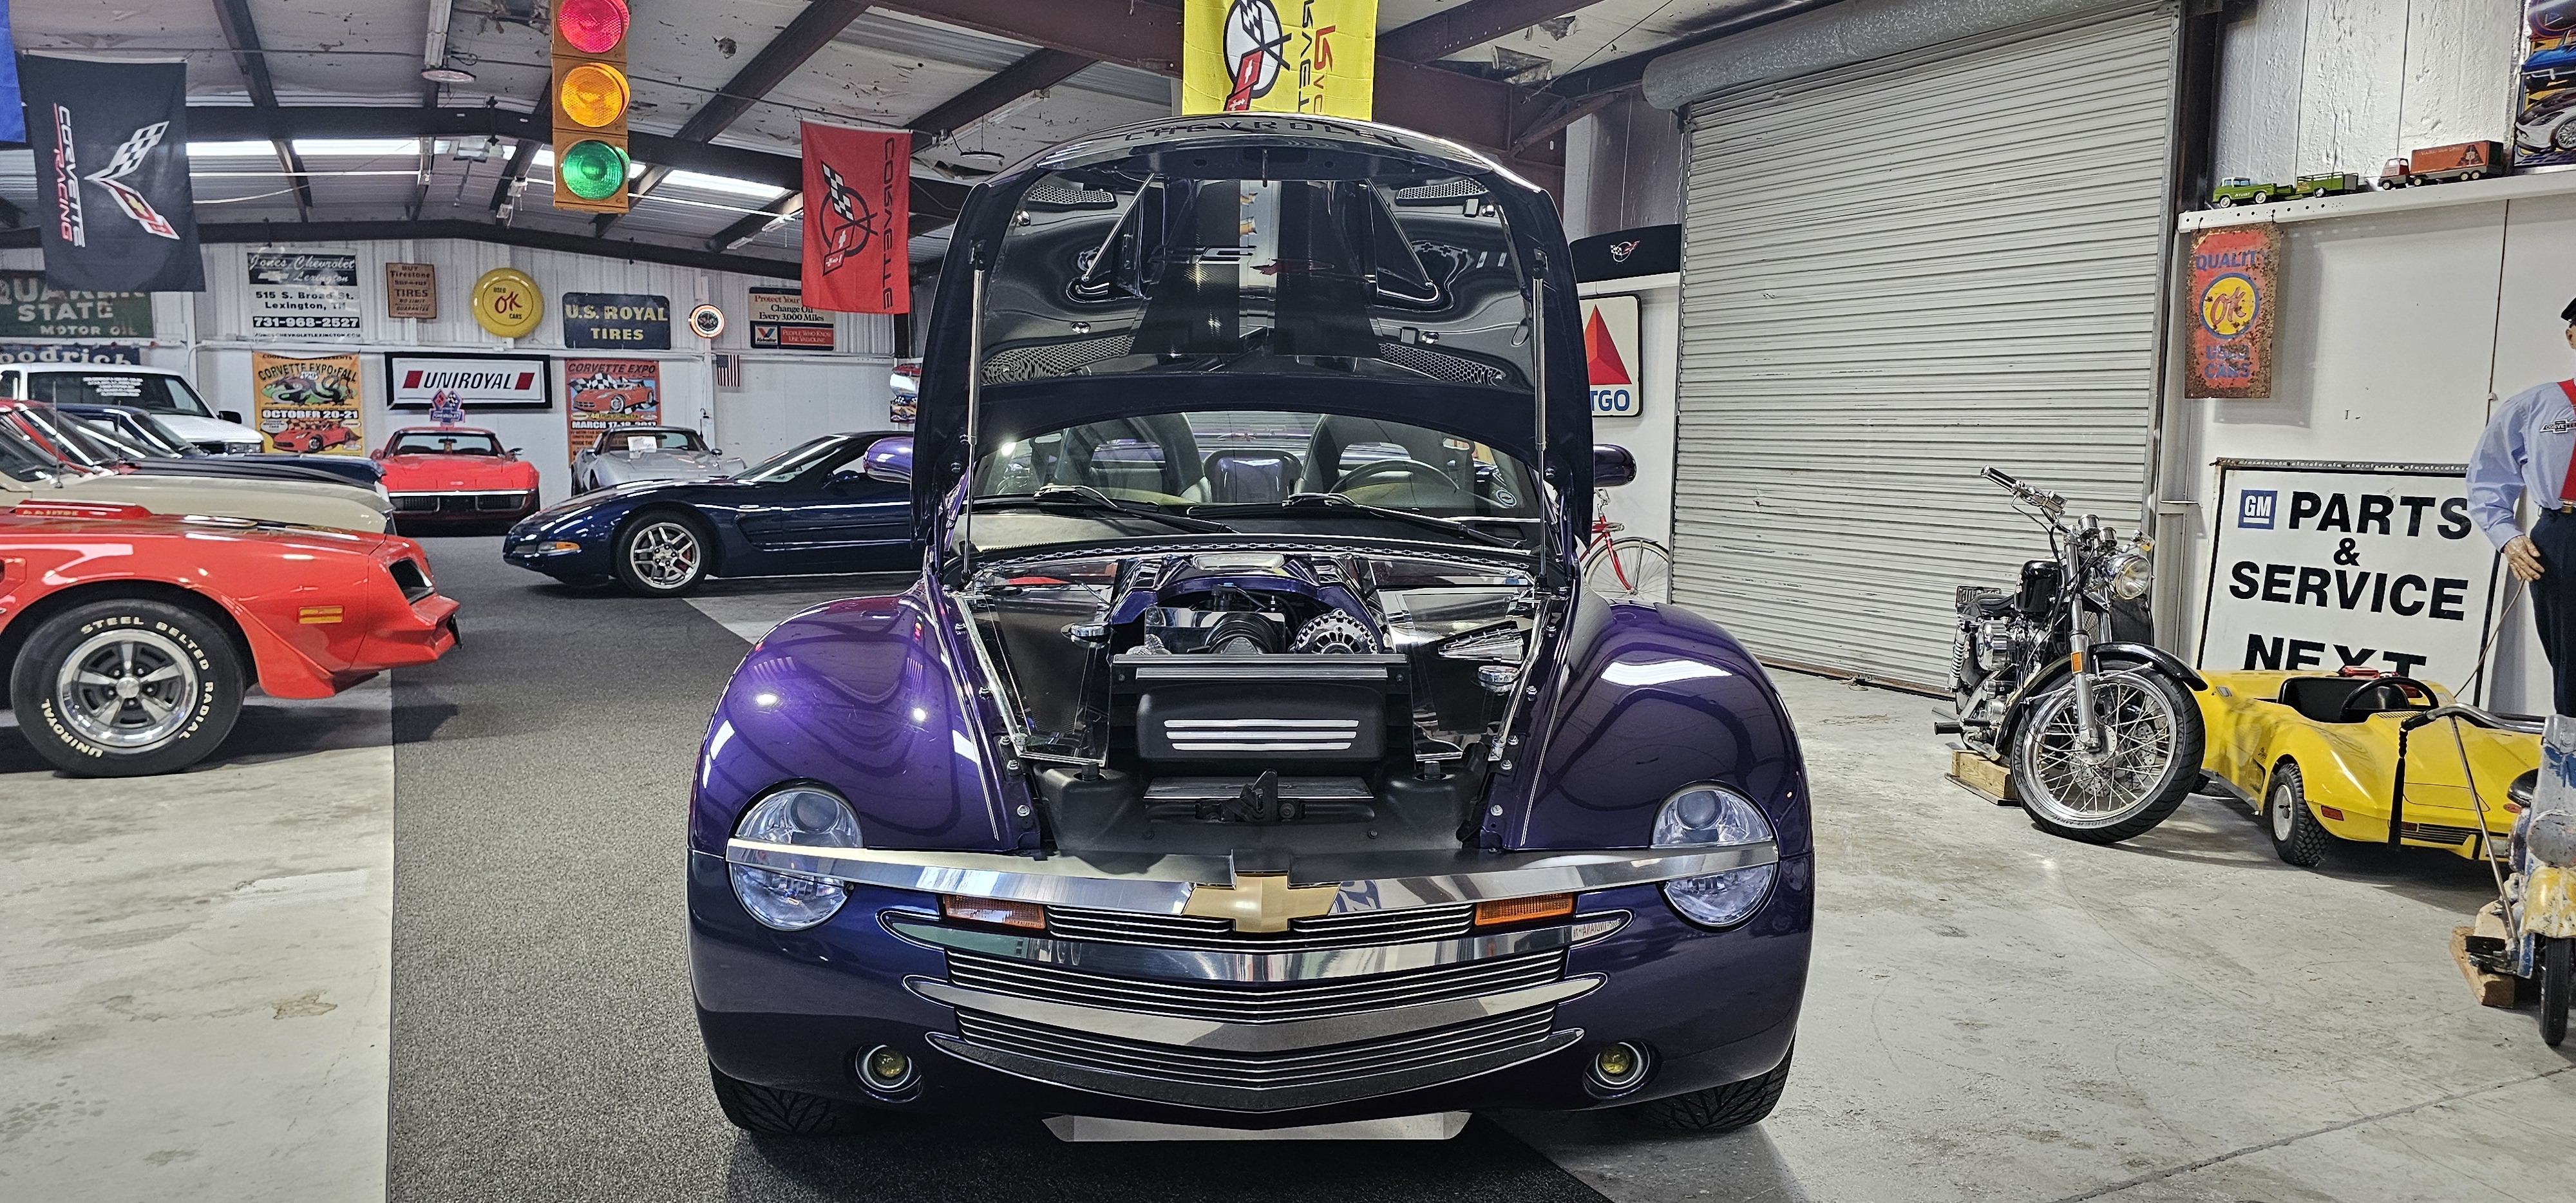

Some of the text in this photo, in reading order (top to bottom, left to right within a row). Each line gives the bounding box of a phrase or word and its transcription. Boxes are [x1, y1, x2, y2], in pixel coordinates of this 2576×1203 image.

[1124, 120, 1409, 144] CHEVROLET
[53, 102, 73, 242] RACING
[59, 106, 86, 248] CORVETTE
[249, 254, 355, 271] Jones Chevrolet
[293, 271, 349, 285] Lexington
[256, 291, 276, 299] 515
[298, 292, 333, 300] Broad
[393, 289, 428, 298] TIRES
[495, 291, 523, 314] OK
[17, 301, 114, 322] STATE
[265, 301, 327, 311] Lexington,
[565, 305, 668, 322] U.S. ROYAL
[771, 304, 800, 314] Change
[2210, 286, 2247, 326] OK
[254, 317, 359, 328] 731-968-2527
[759, 312, 781, 321] Every
[39, 325, 101, 336] MOTOR
[591, 327, 644, 341] TIRES
[0, 346, 132, 366] oodrich
[258, 363, 307, 381] CORVETTE
[309, 363, 334, 375] EXPO
[568, 363, 656, 374] CORVETTE EXPO
[423, 372, 513, 390] UNIROYAL
[1590, 389, 1631, 412] TGO
[262, 410, 359, 419] OCTOBER 20-21
[572, 421, 607, 429] MARCH
[2244, 495, 2271, 517] GM
[2288, 491, 2473, 540] PARTS
[2333, 537, 2360, 567] &
[2229, 560, 2469, 621] SERVICE
[81, 616, 214, 740] STEEL BELTED RADIAL
[41, 698, 104, 759] UNIROYAL
[2014, 735, 2025, 773] AVON
